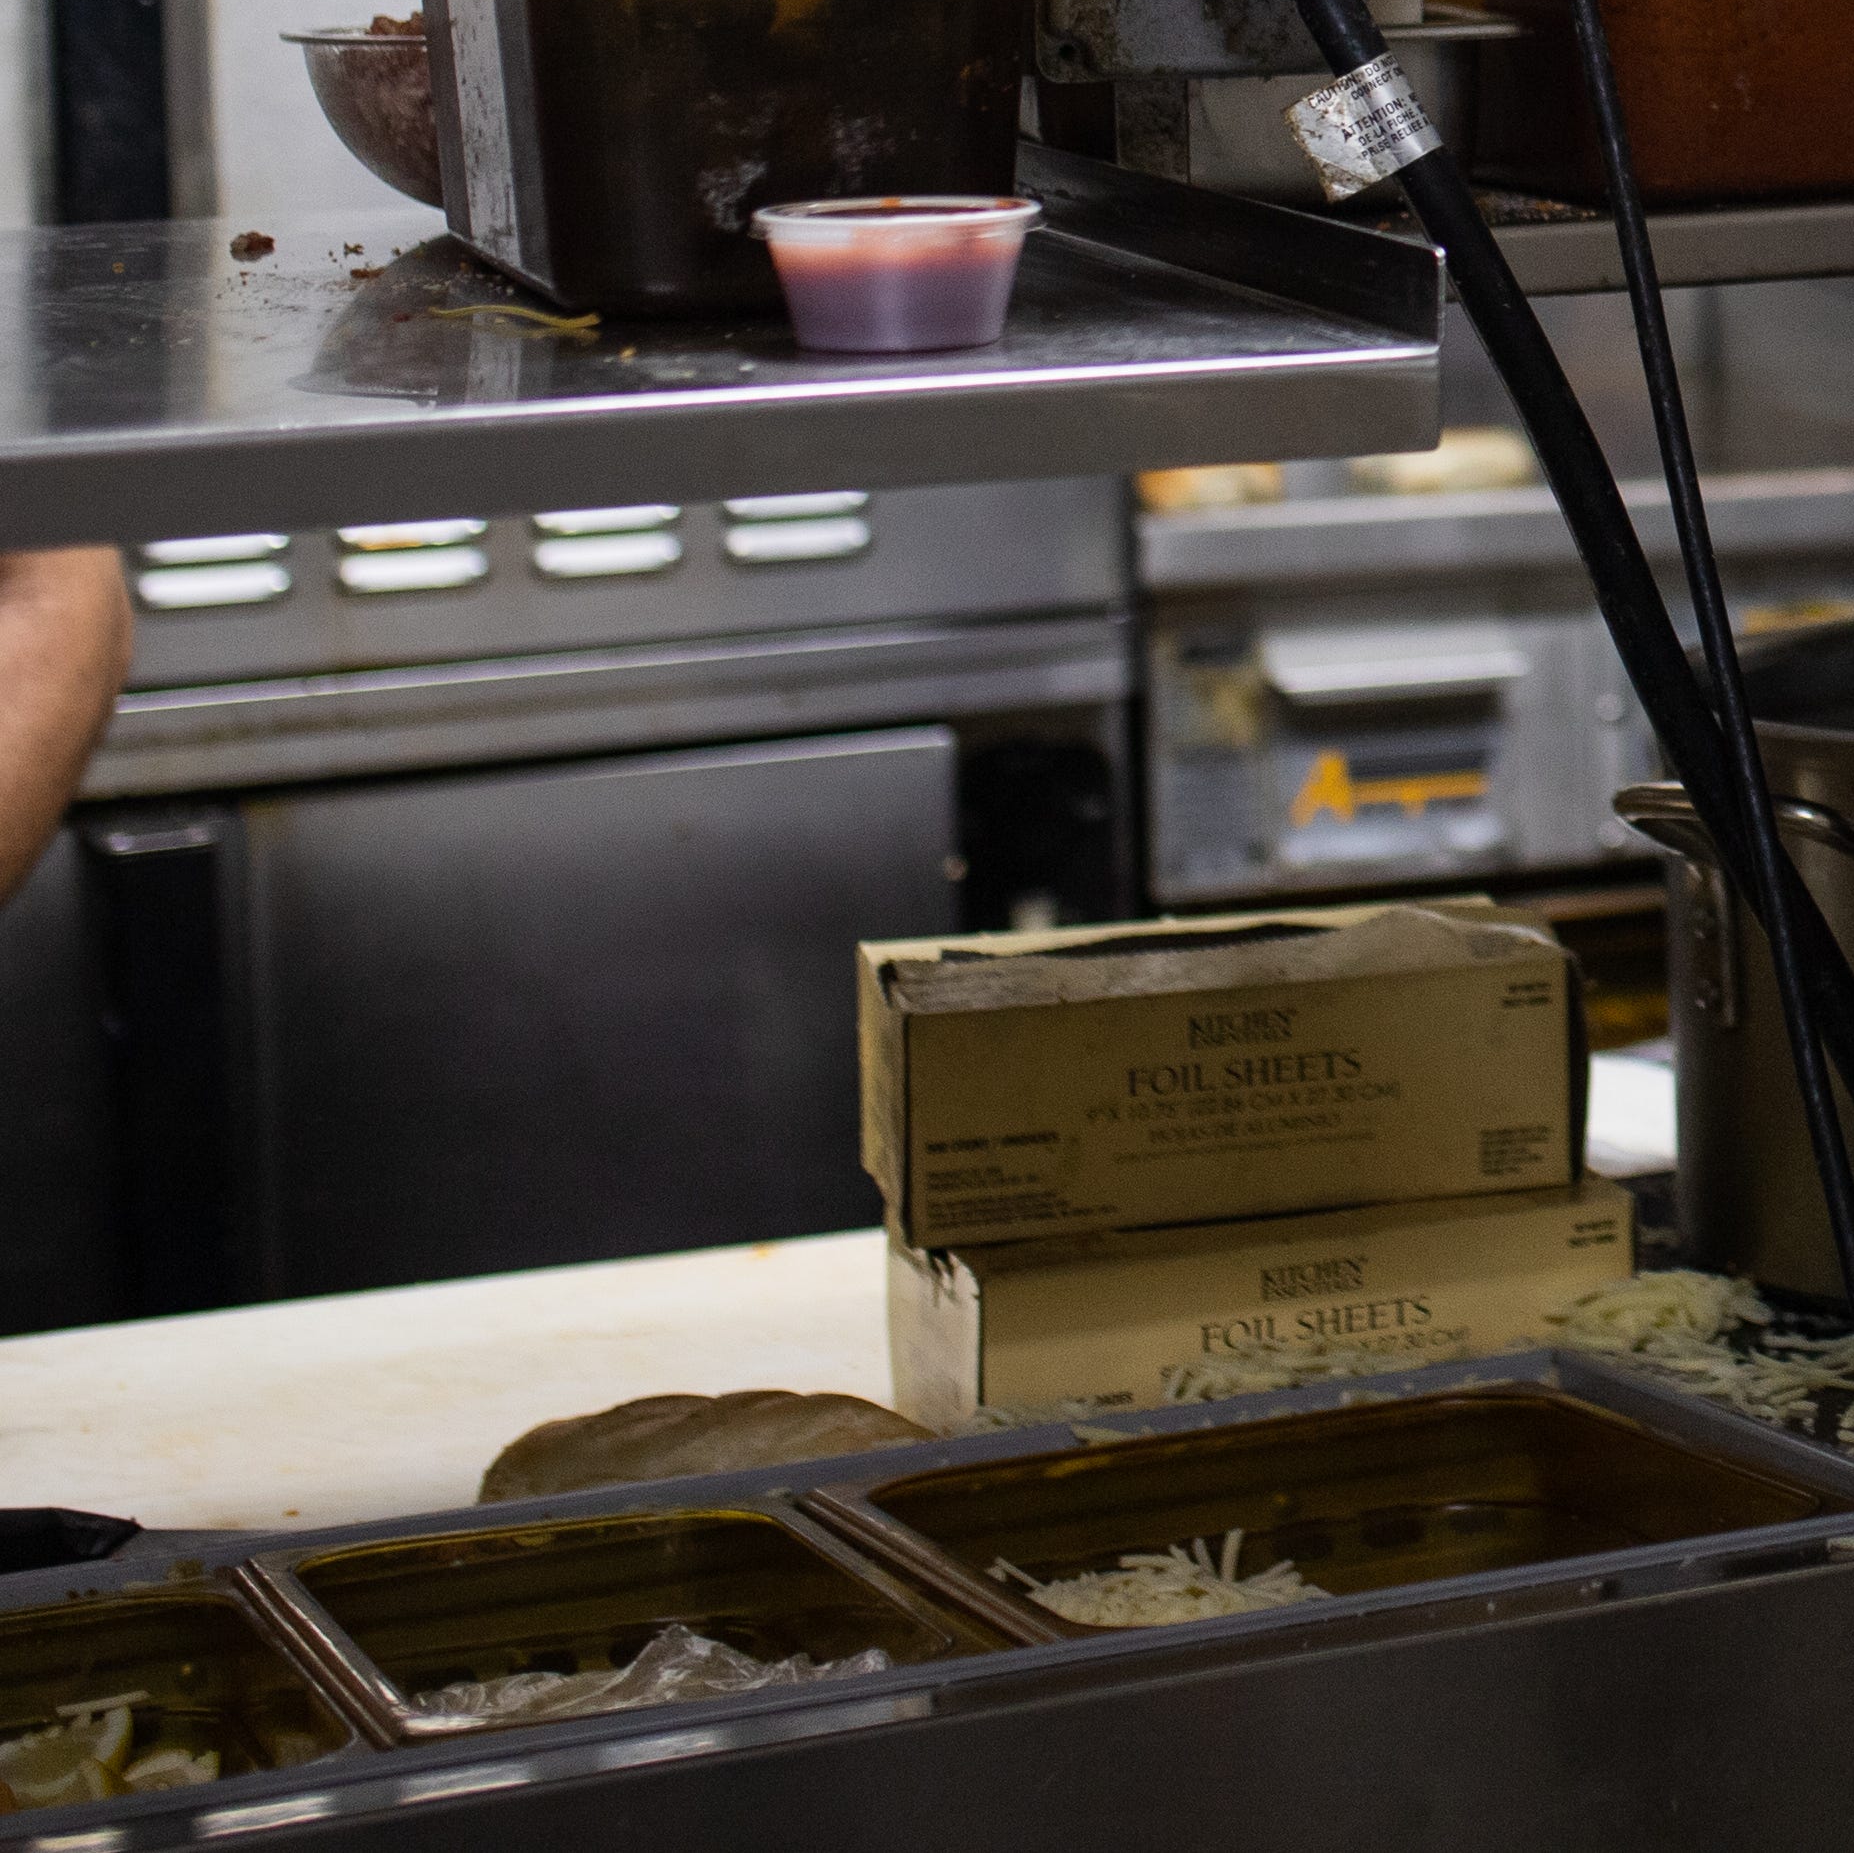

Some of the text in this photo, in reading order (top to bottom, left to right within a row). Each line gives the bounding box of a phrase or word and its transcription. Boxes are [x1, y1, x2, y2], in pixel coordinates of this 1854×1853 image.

[1351, 69, 1394, 101] CONNECT
[1365, 62, 1380, 78] DO
[1342, 96, 1408, 143] ATTENTION:
[1126, 1048, 1364, 1097] FOIL SHEETS
[1200, 1294, 1433, 1353] FOIL SHEETS
